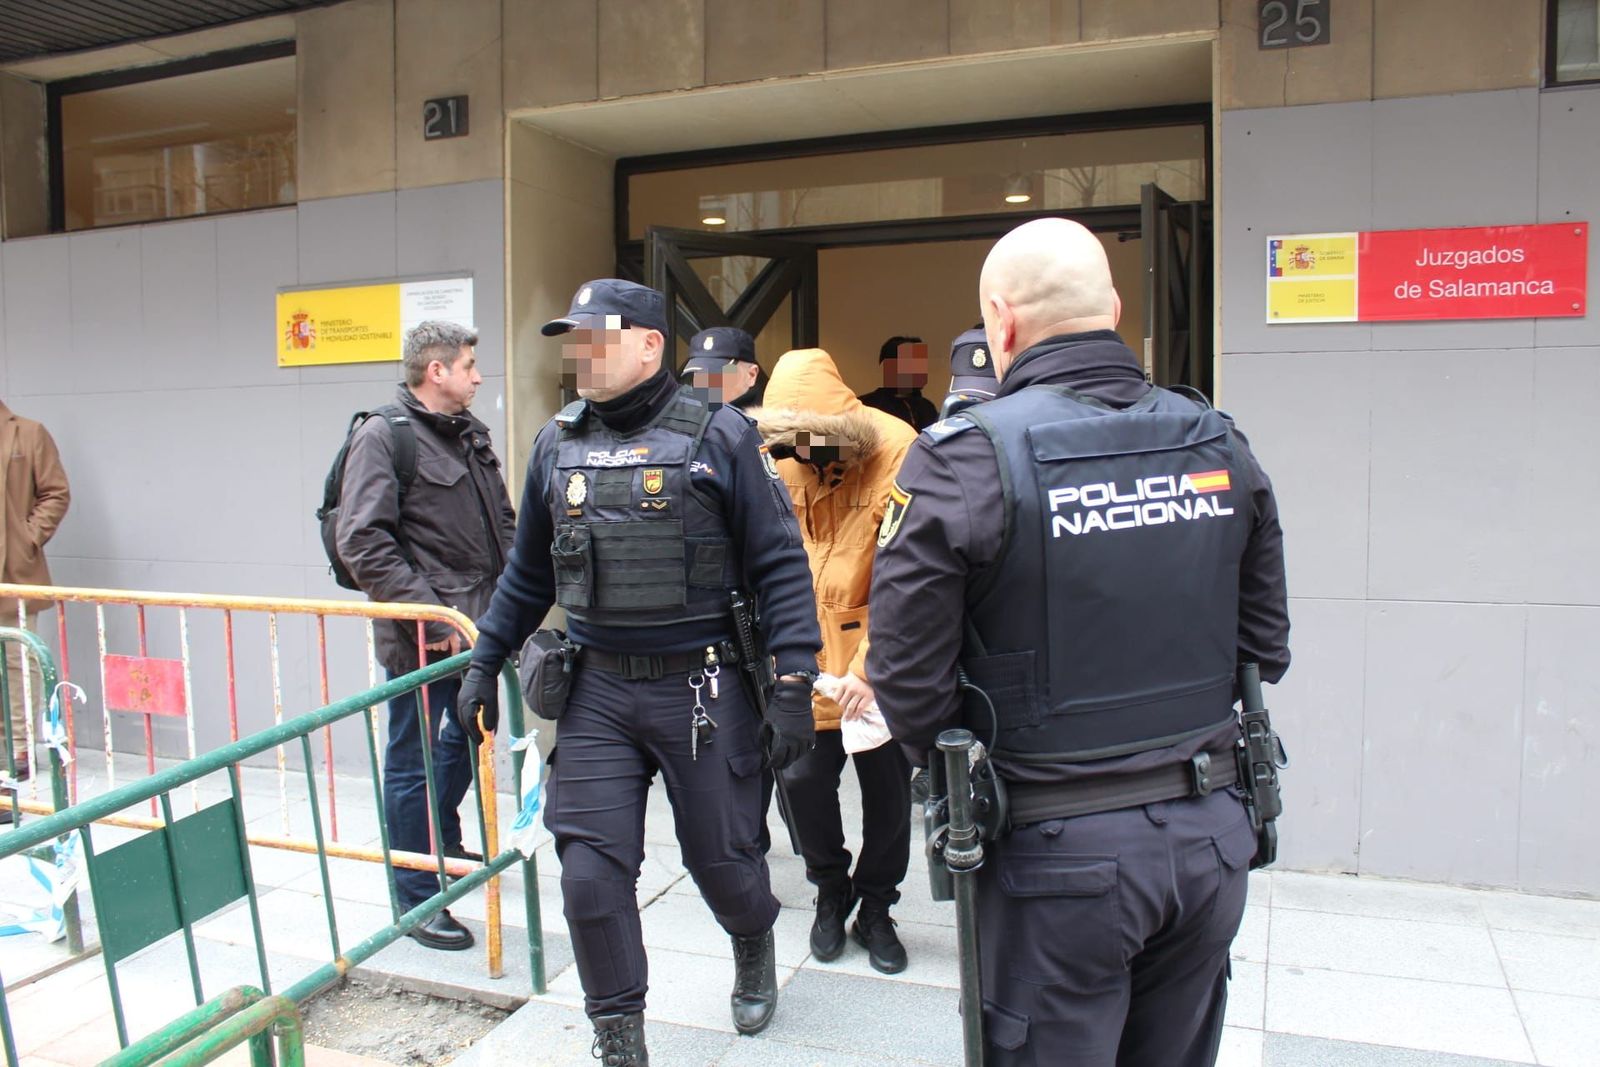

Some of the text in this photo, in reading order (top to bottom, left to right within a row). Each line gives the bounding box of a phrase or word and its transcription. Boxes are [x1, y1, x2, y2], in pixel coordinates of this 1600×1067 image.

[1262, 0, 1321, 45] 25
[424, 100, 457, 137] 21
[1415, 245, 1525, 270] Juzgados
[1393, 279, 1555, 299] de Salamanca
[320, 318, 353, 327] MINISTERIO
[329, 325, 369, 334] TRANSPORTES
[326, 334, 358, 342] MOVILIDAD
[359, 332, 393, 340] SOSTENIBLE
[586, 456, 648, 466] NACIONAL
[587, 449, 637, 460] POLICIA
[1048, 474, 1199, 512] POLICIA
[1052, 495, 1235, 538] NACIONAL
